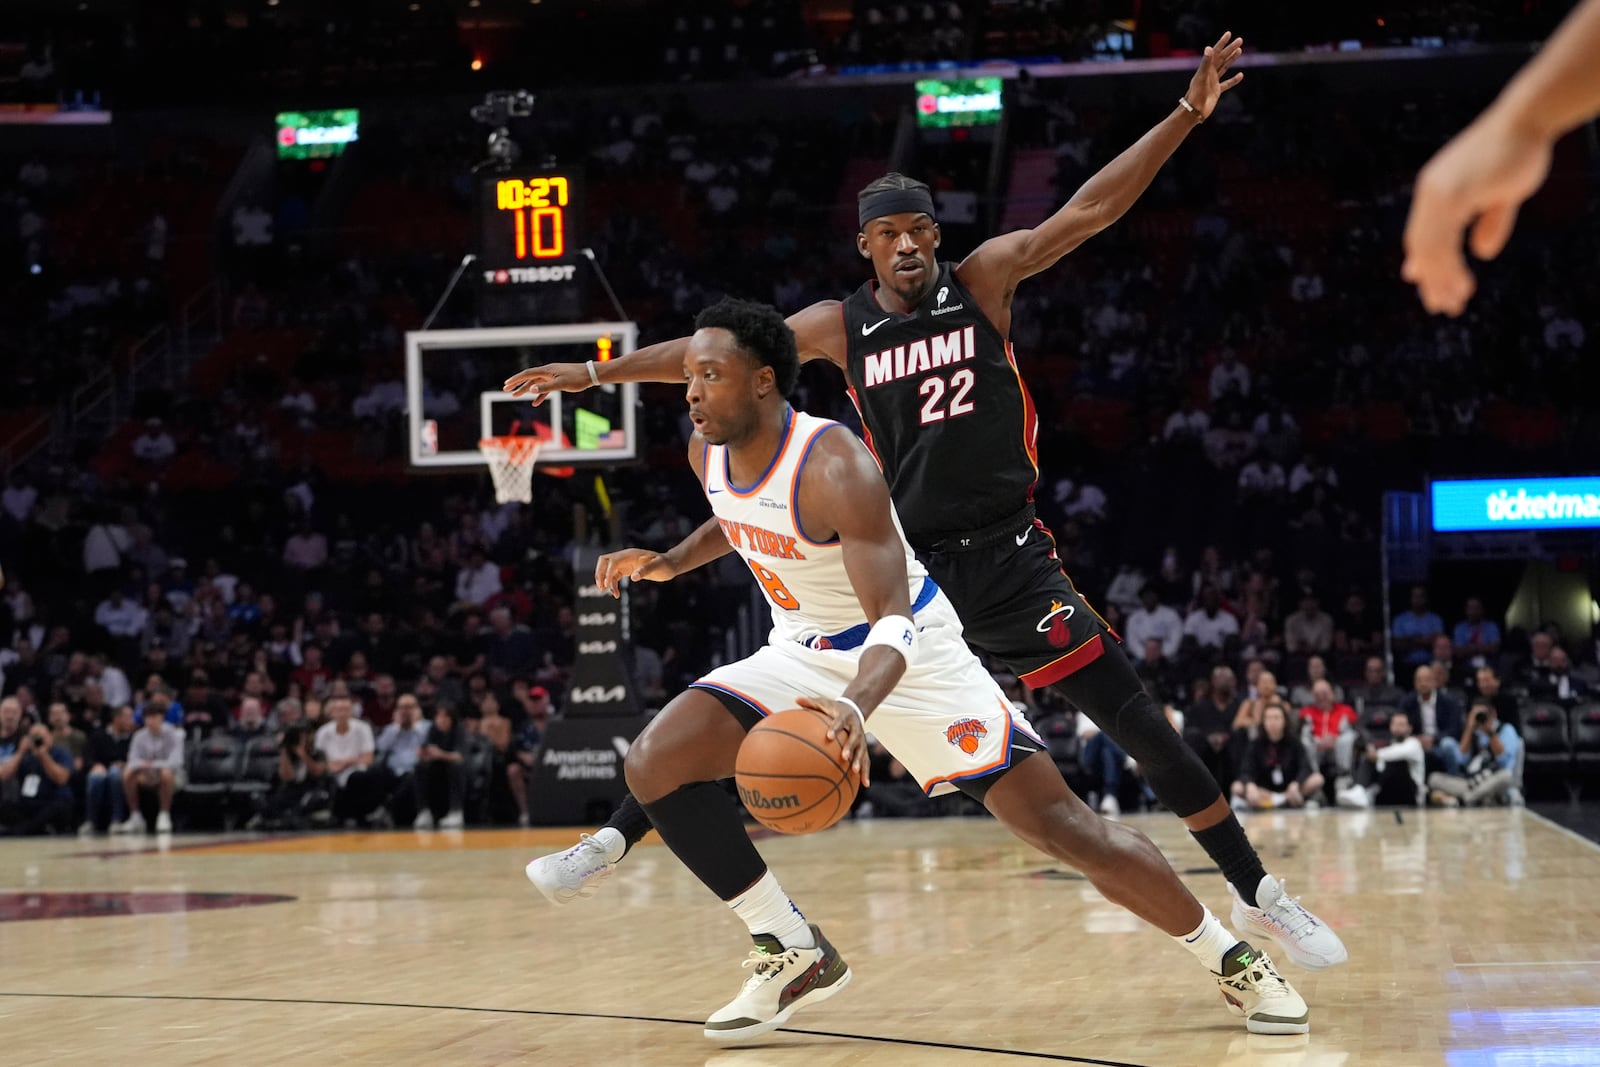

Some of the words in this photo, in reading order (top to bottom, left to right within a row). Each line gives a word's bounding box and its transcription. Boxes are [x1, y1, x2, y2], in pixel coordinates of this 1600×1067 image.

[497, 177, 568, 209] 10:27
[515, 207, 563, 259] 10
[509, 265, 576, 283] TISSOT
[930, 303, 964, 317] Robinhood
[864, 324, 976, 388] MIAMI
[918, 367, 975, 425] 22
[1487, 488, 1600, 520] ticketma
[740, 523, 806, 560] YORK
[748, 558, 800, 611] 8
[543, 748, 617, 766] American
[557, 765, 617, 780] Airlines
